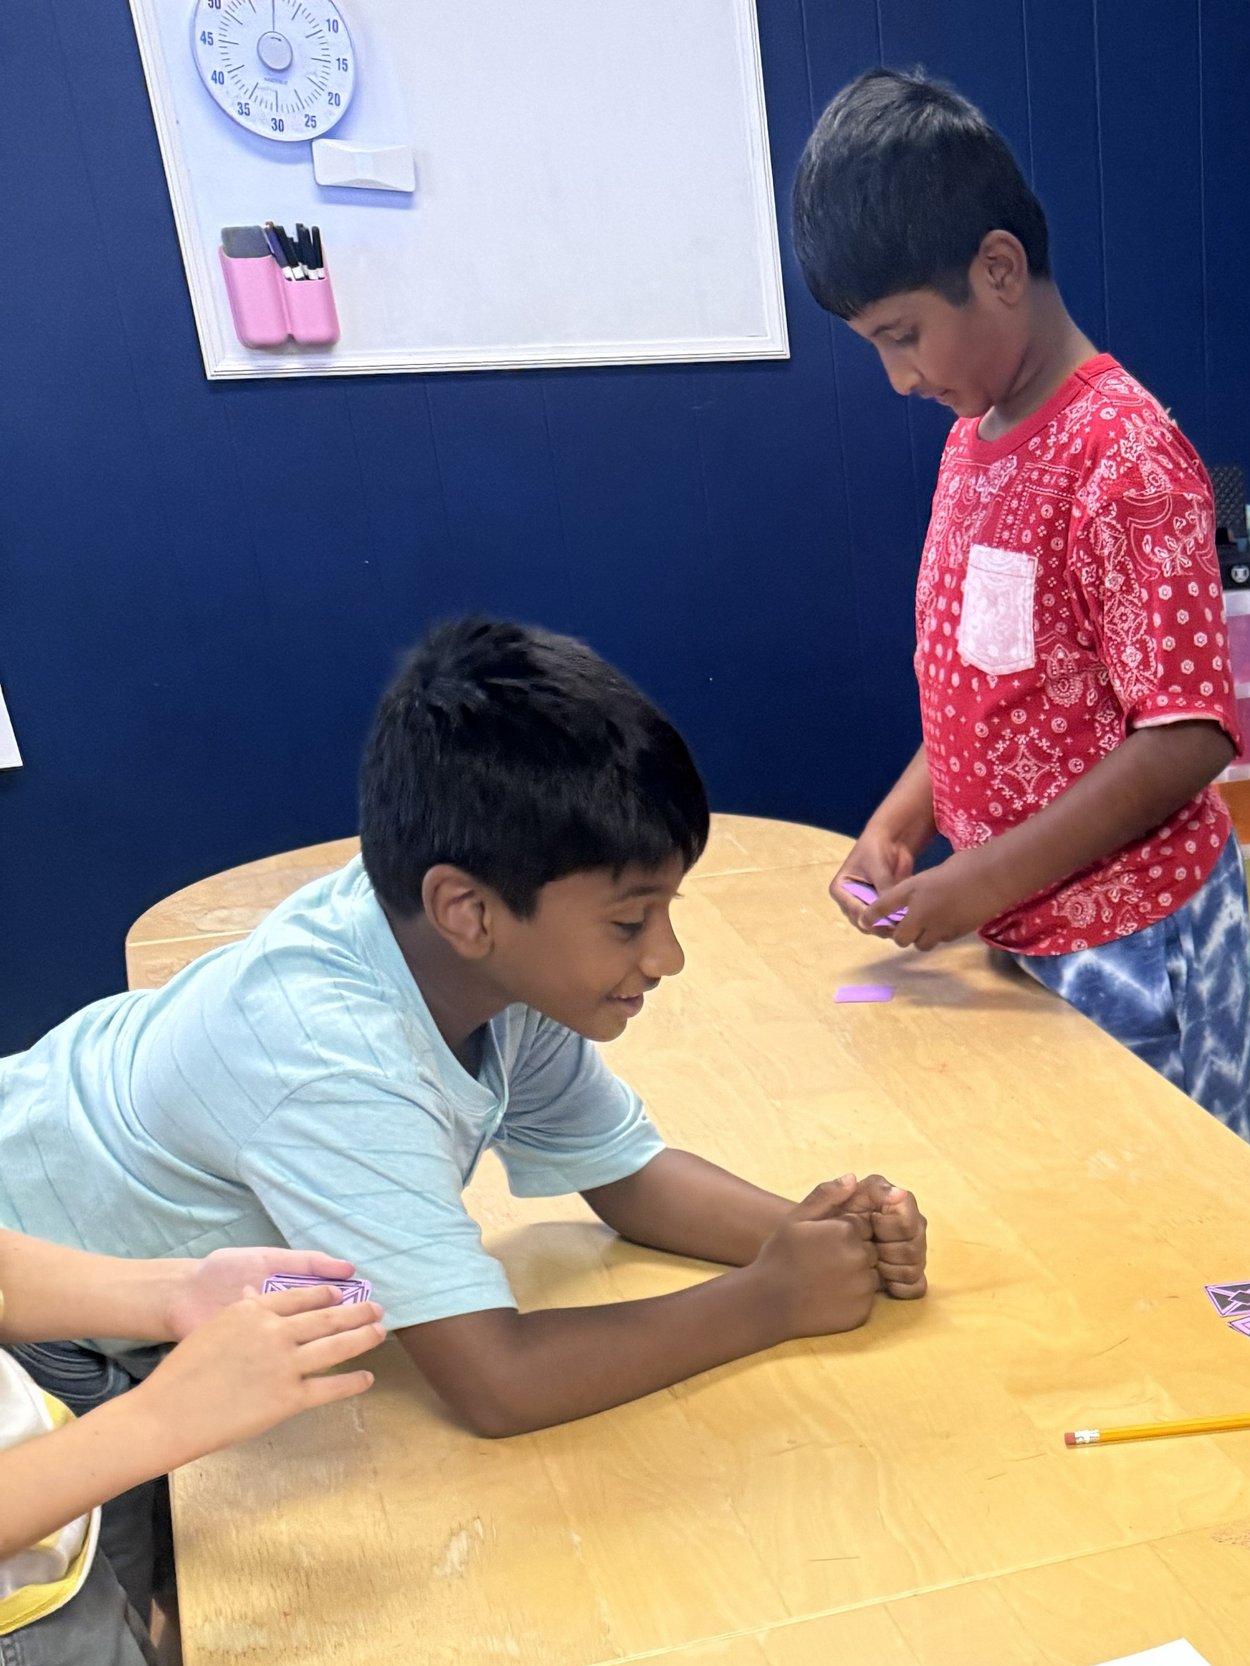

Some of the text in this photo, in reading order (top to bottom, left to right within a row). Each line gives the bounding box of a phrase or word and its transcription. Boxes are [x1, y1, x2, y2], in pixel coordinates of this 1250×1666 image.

[326, 18, 339, 34] 10
[200, 30, 214, 46] 45
[336, 57, 349, 72] 15
[211, 70, 225, 86] 40
[327, 92, 341, 107] 20
[237, 102, 251, 117] 35
[271, 118, 285, 133] 30
[304, 114, 318, 129] 25
